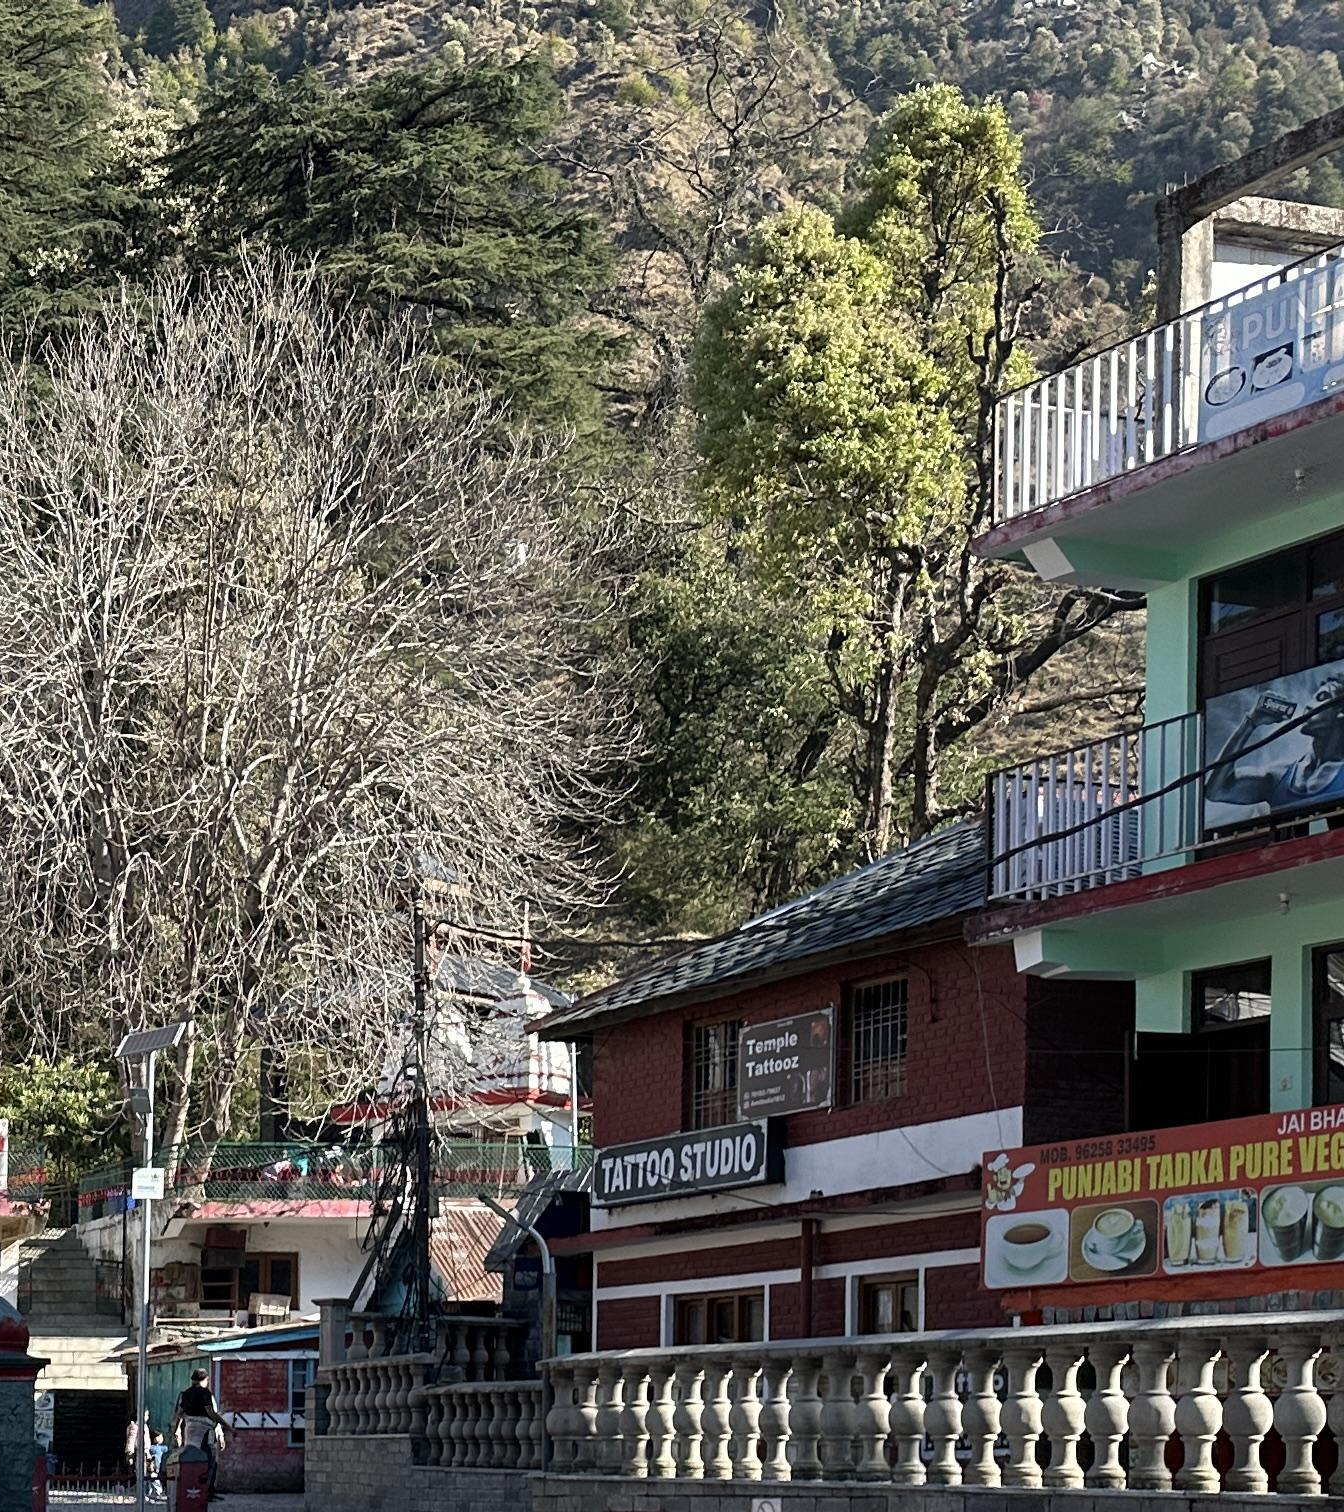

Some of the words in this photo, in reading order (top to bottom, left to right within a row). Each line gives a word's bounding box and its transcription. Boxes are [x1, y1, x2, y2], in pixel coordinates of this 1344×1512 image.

[746, 1031, 798, 1056] Temple
[745, 1055, 799, 1079] Tattooz
[1277, 1112, 1305, 1135] JAI
[601, 1147, 675, 1194] TATTOO
[679, 1132, 757, 1182] STUDIO
[1039, 1146, 1072, 1165] MOB.
[1047, 1156, 1142, 1202] PUNJABI
[1146, 1147, 1224, 1191] TADKA
[1229, 1137, 1293, 1181] PURE
[1297, 1130, 1344, 1174] VEG
